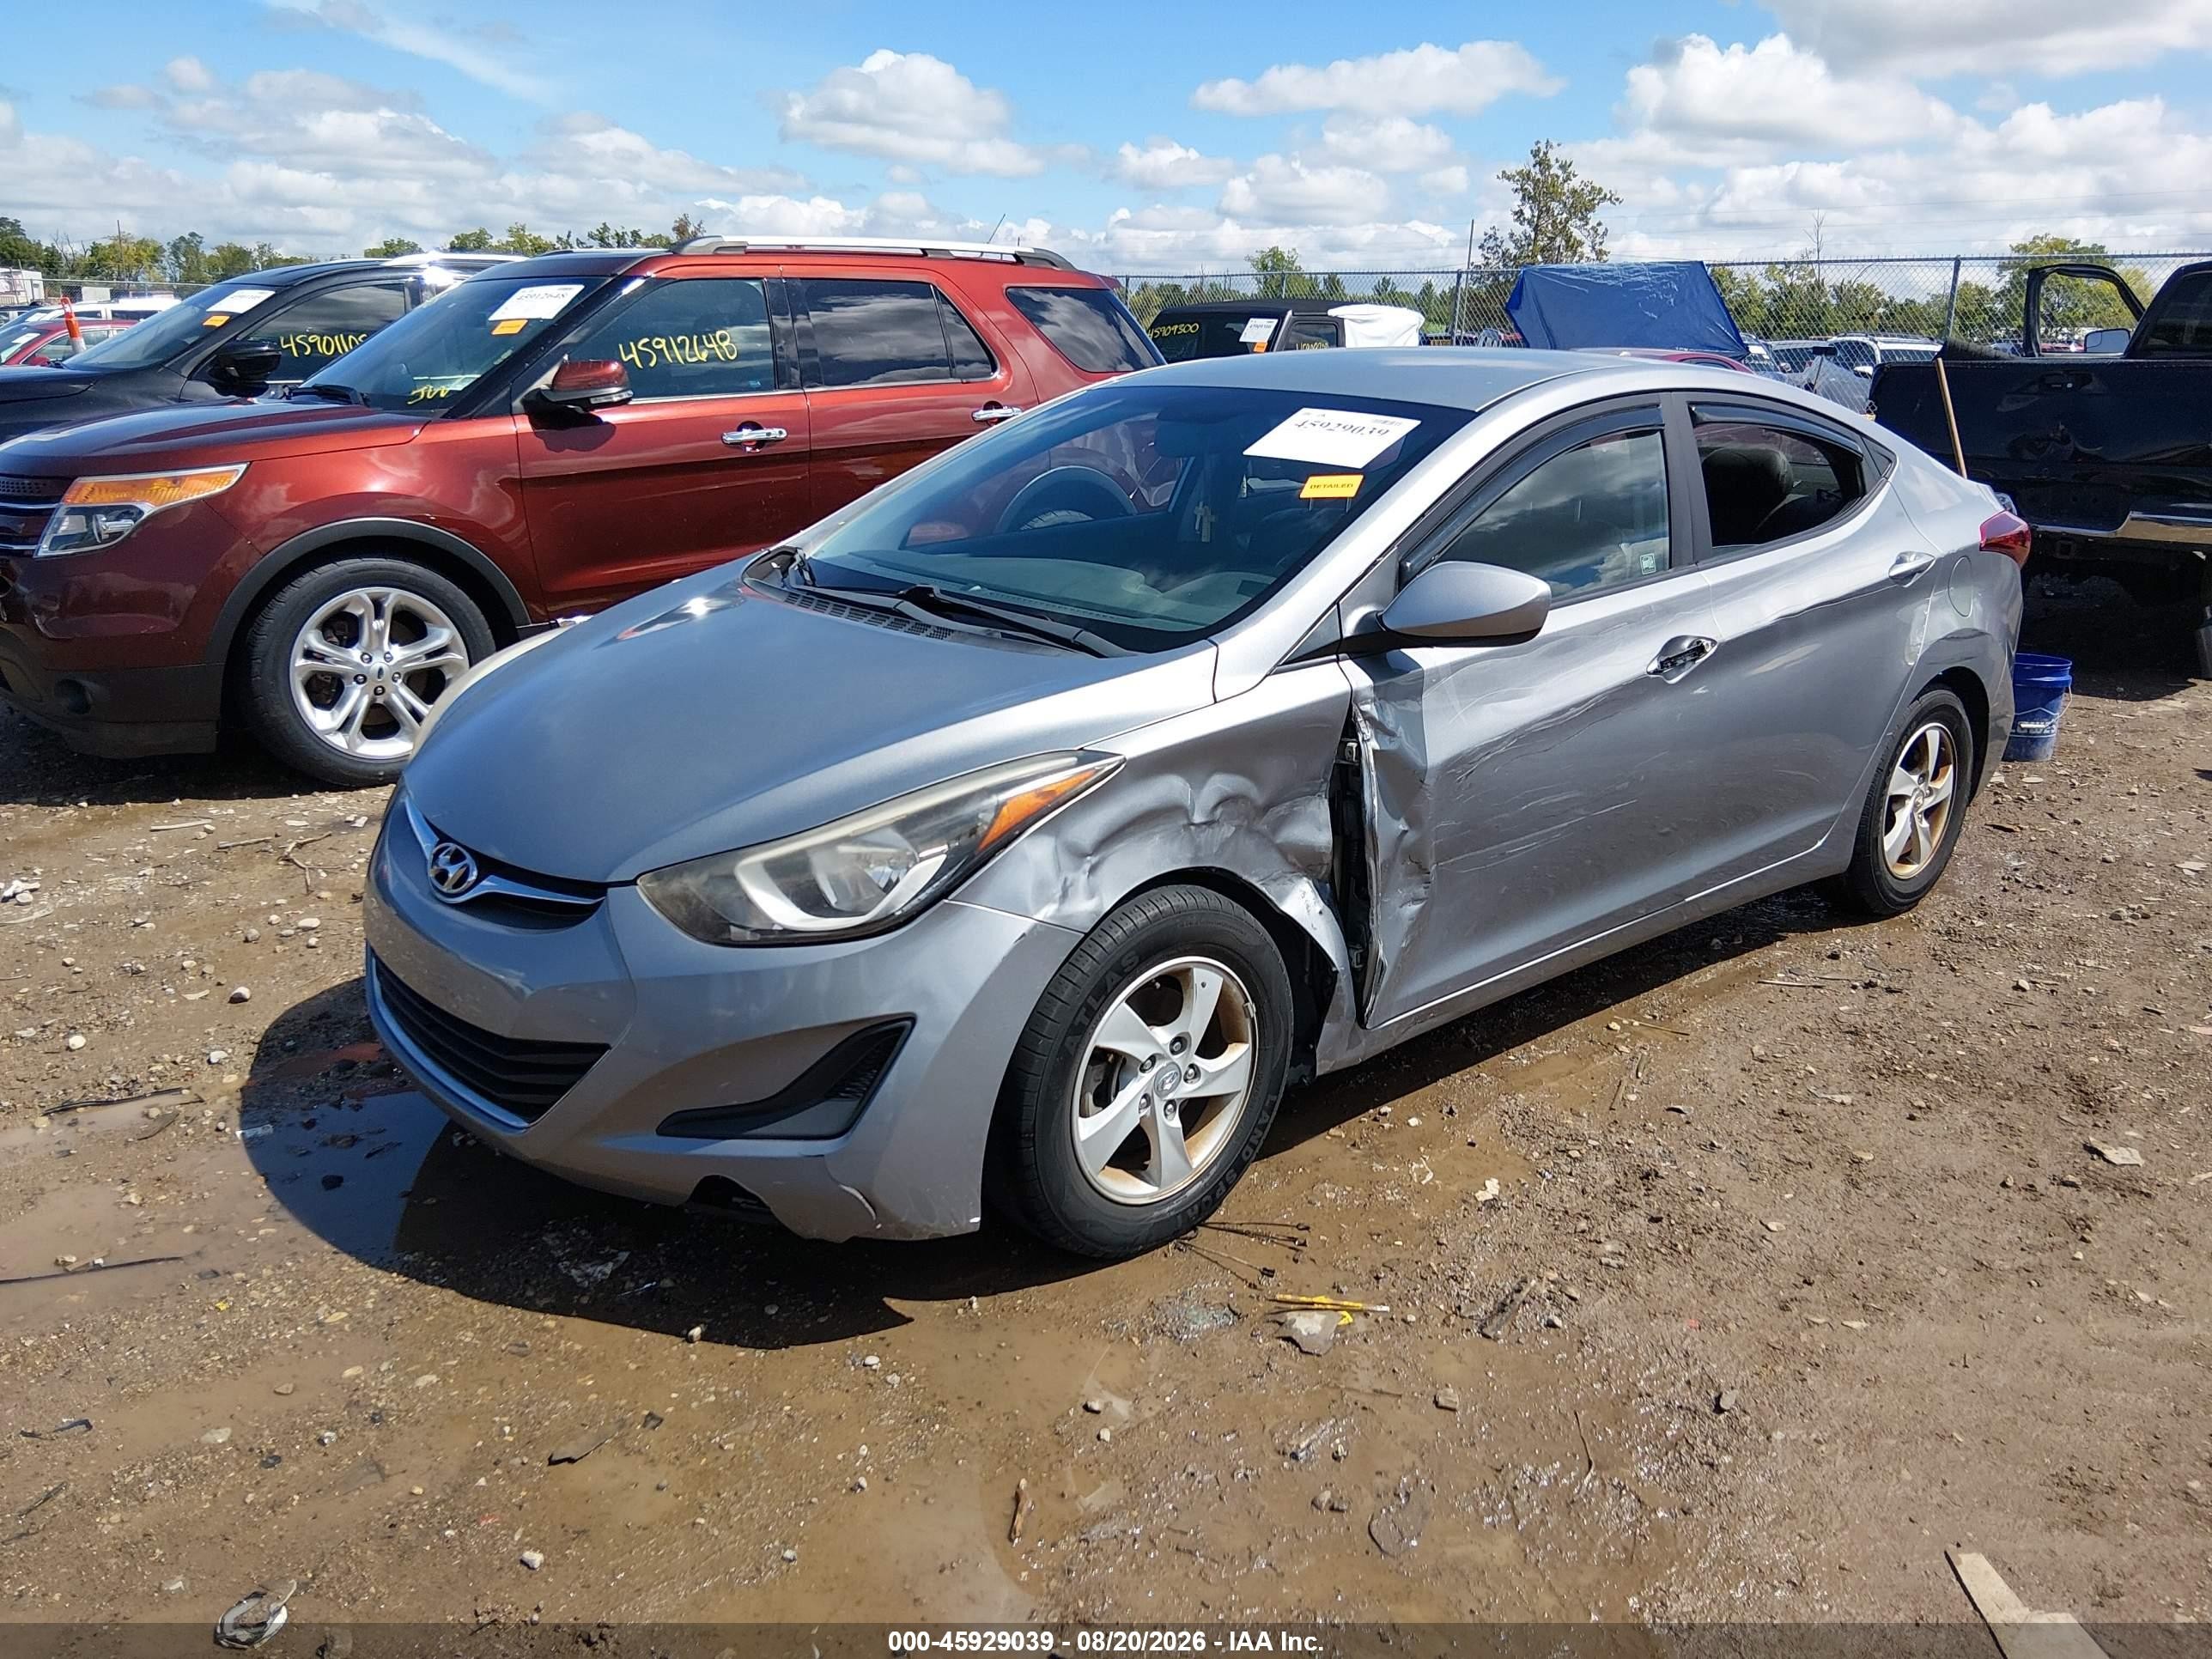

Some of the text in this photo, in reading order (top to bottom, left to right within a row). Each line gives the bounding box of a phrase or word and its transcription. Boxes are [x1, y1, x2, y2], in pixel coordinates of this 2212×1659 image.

[618, 330, 738, 369] 45912648
[1148, 323, 1200, 339] 45909300
[1062, 950, 1141, 1054] ATLAS
